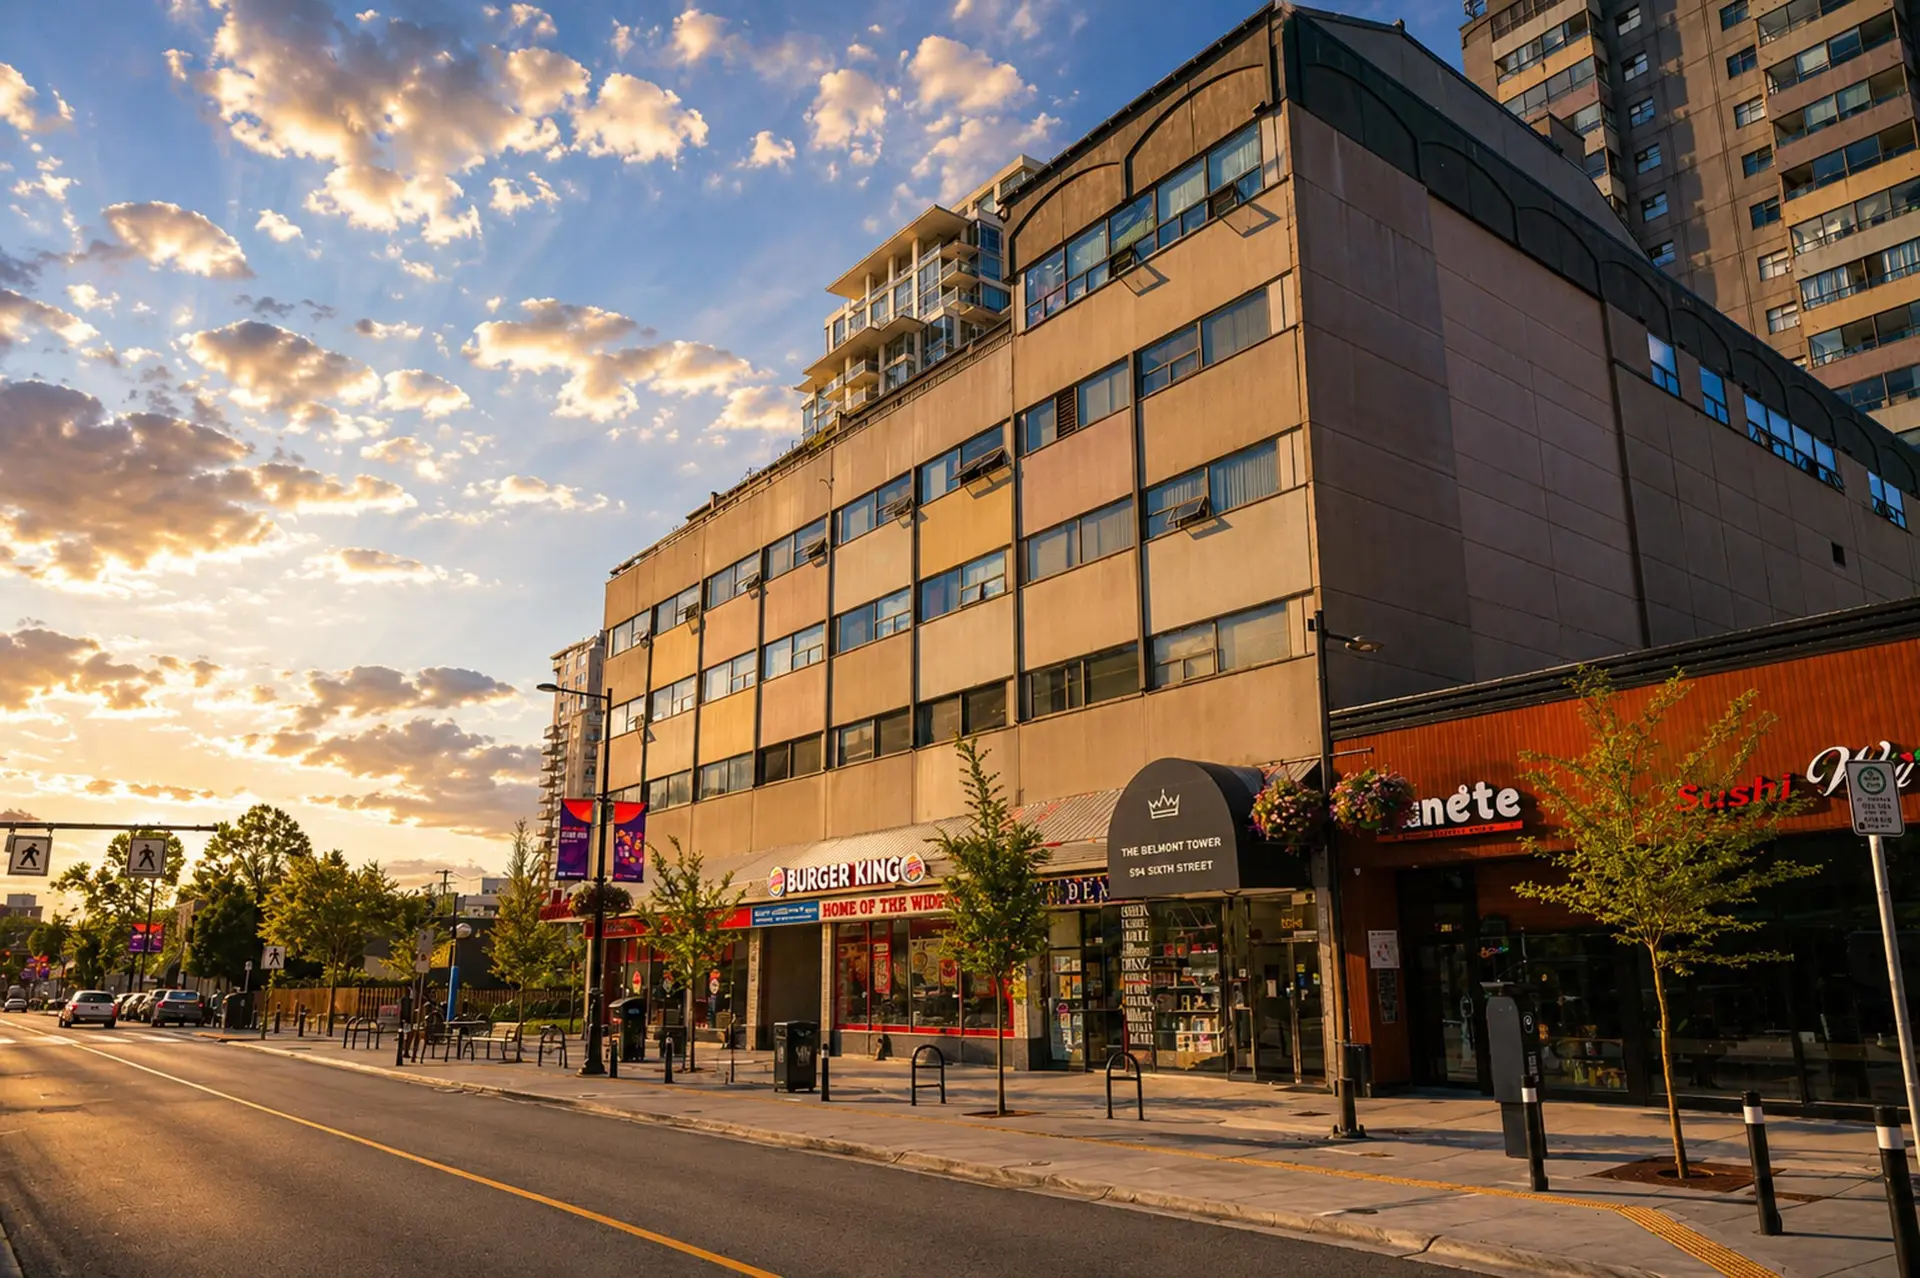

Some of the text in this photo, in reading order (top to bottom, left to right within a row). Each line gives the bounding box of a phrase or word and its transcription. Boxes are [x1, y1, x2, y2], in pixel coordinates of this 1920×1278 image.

[1674, 773, 1791, 813] Sushi
[1121, 837, 1222, 857] THE BELMONT TOWER
[786, 862, 850, 893] BURGER
[855, 856, 900, 886] KING
[1147, 863, 1175, 876] SIXTH
[1176, 860, 1213, 873] STREET
[822, 896, 857, 918] HOME
